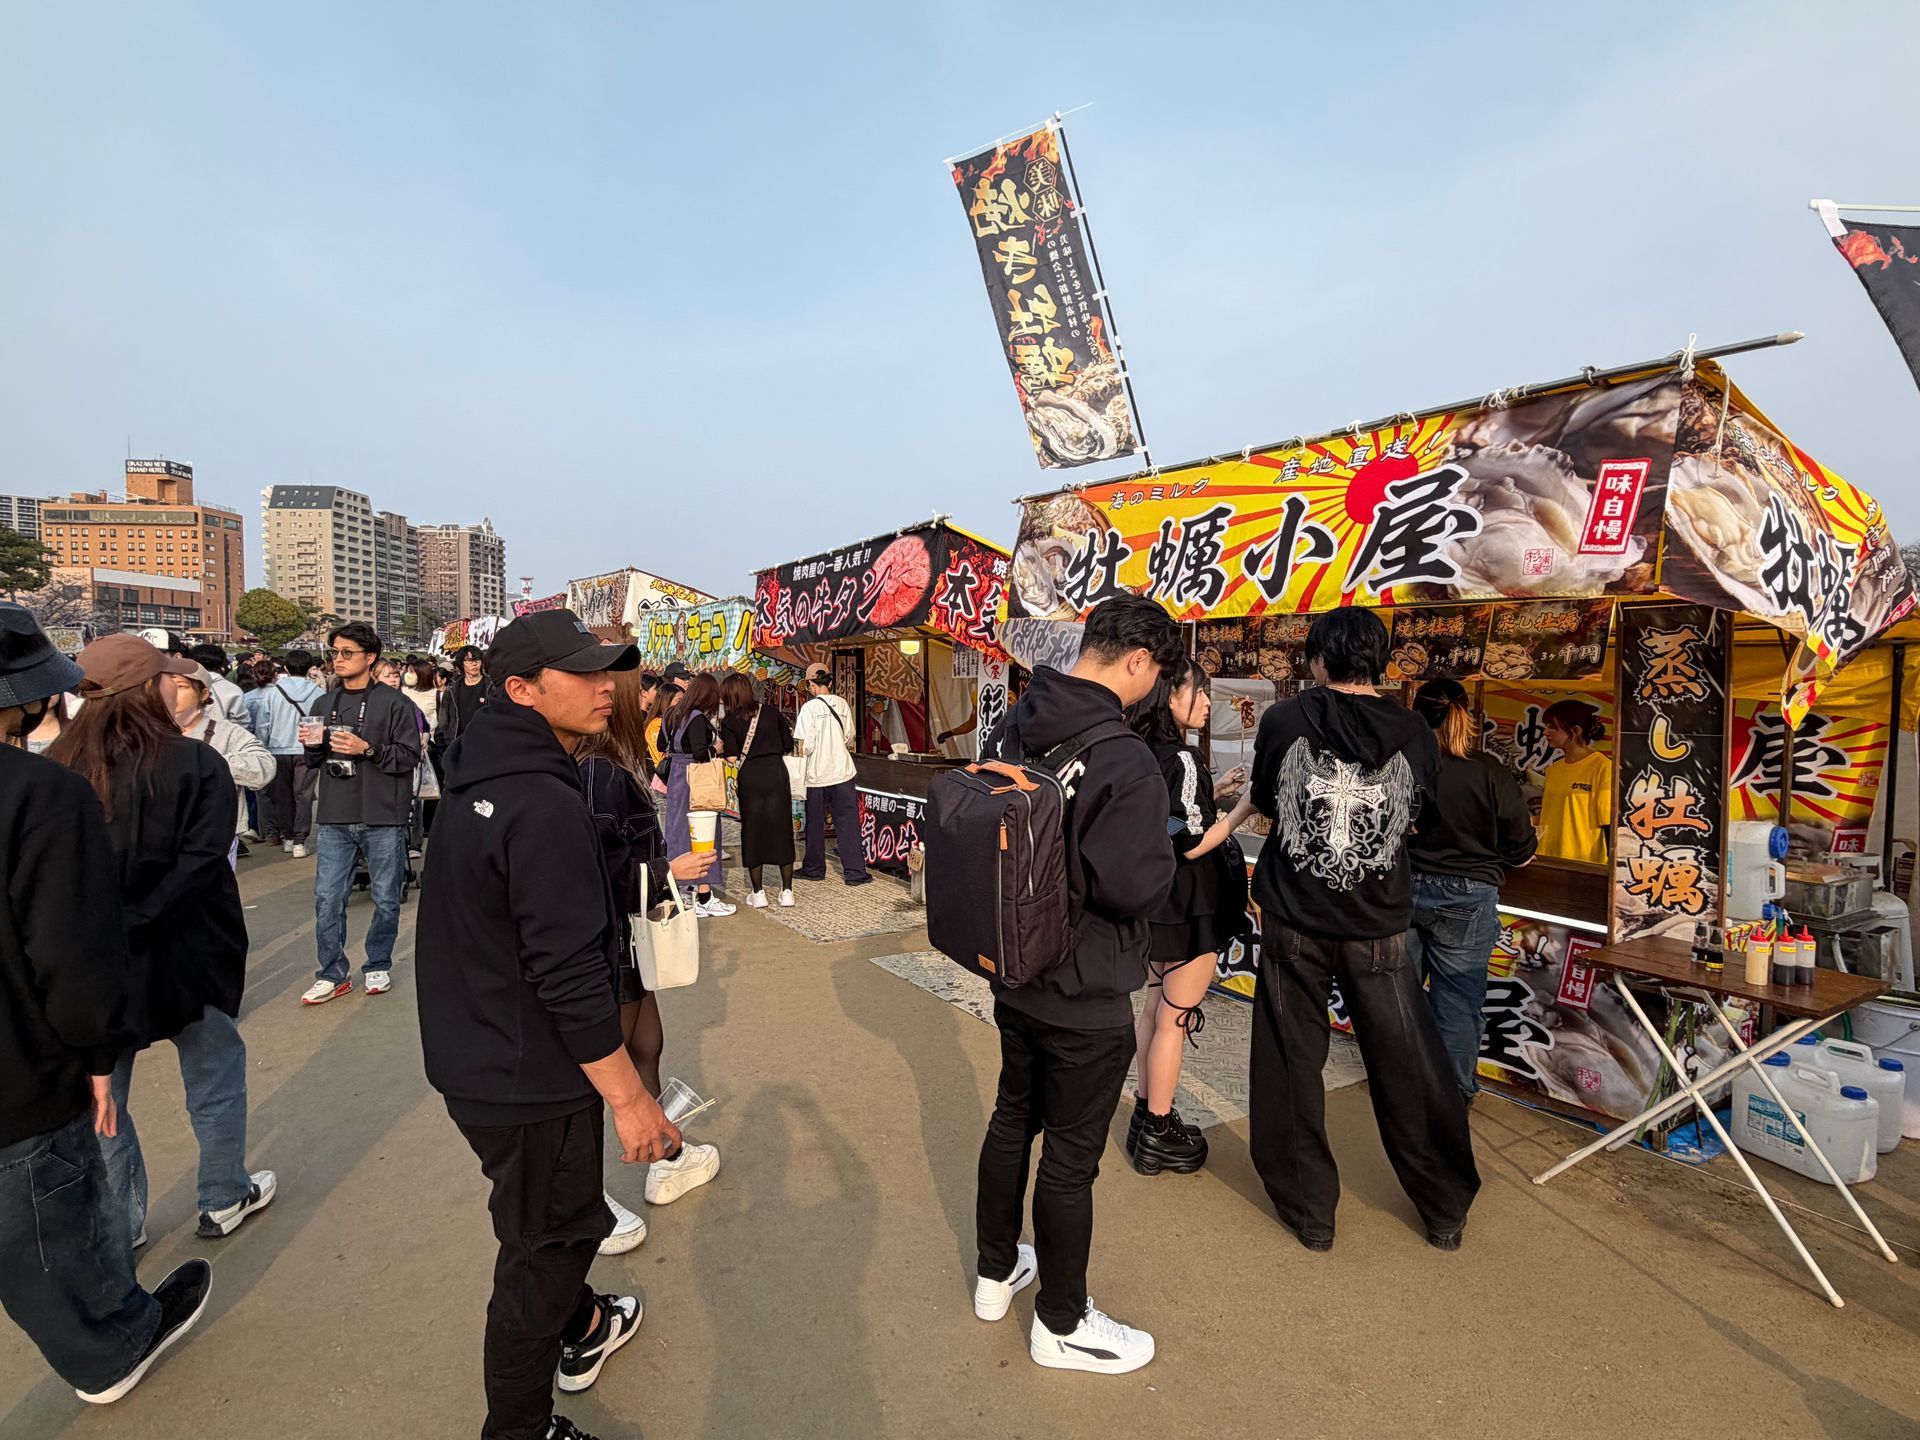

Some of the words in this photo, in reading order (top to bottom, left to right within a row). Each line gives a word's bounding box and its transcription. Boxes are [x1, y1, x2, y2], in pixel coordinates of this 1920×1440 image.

[1274, 429, 1444, 484] 産地直送!
[1109, 477, 1211, 511] 海のミルク
[1592, 473, 1633, 541] 味自慢
[1063, 464, 1484, 612] 牡蠣小屋
[754, 564, 893, 642] 本気の牛タン
[1498, 609, 1579, 634] 蒸し牡蠣
[1397, 614, 1464, 638] 焼き牡蠣
[1448, 646, 1482, 666] 千円
[1558, 642, 1602, 665] 千円
[1625, 626, 1711, 914] 蒸し牡蠣
